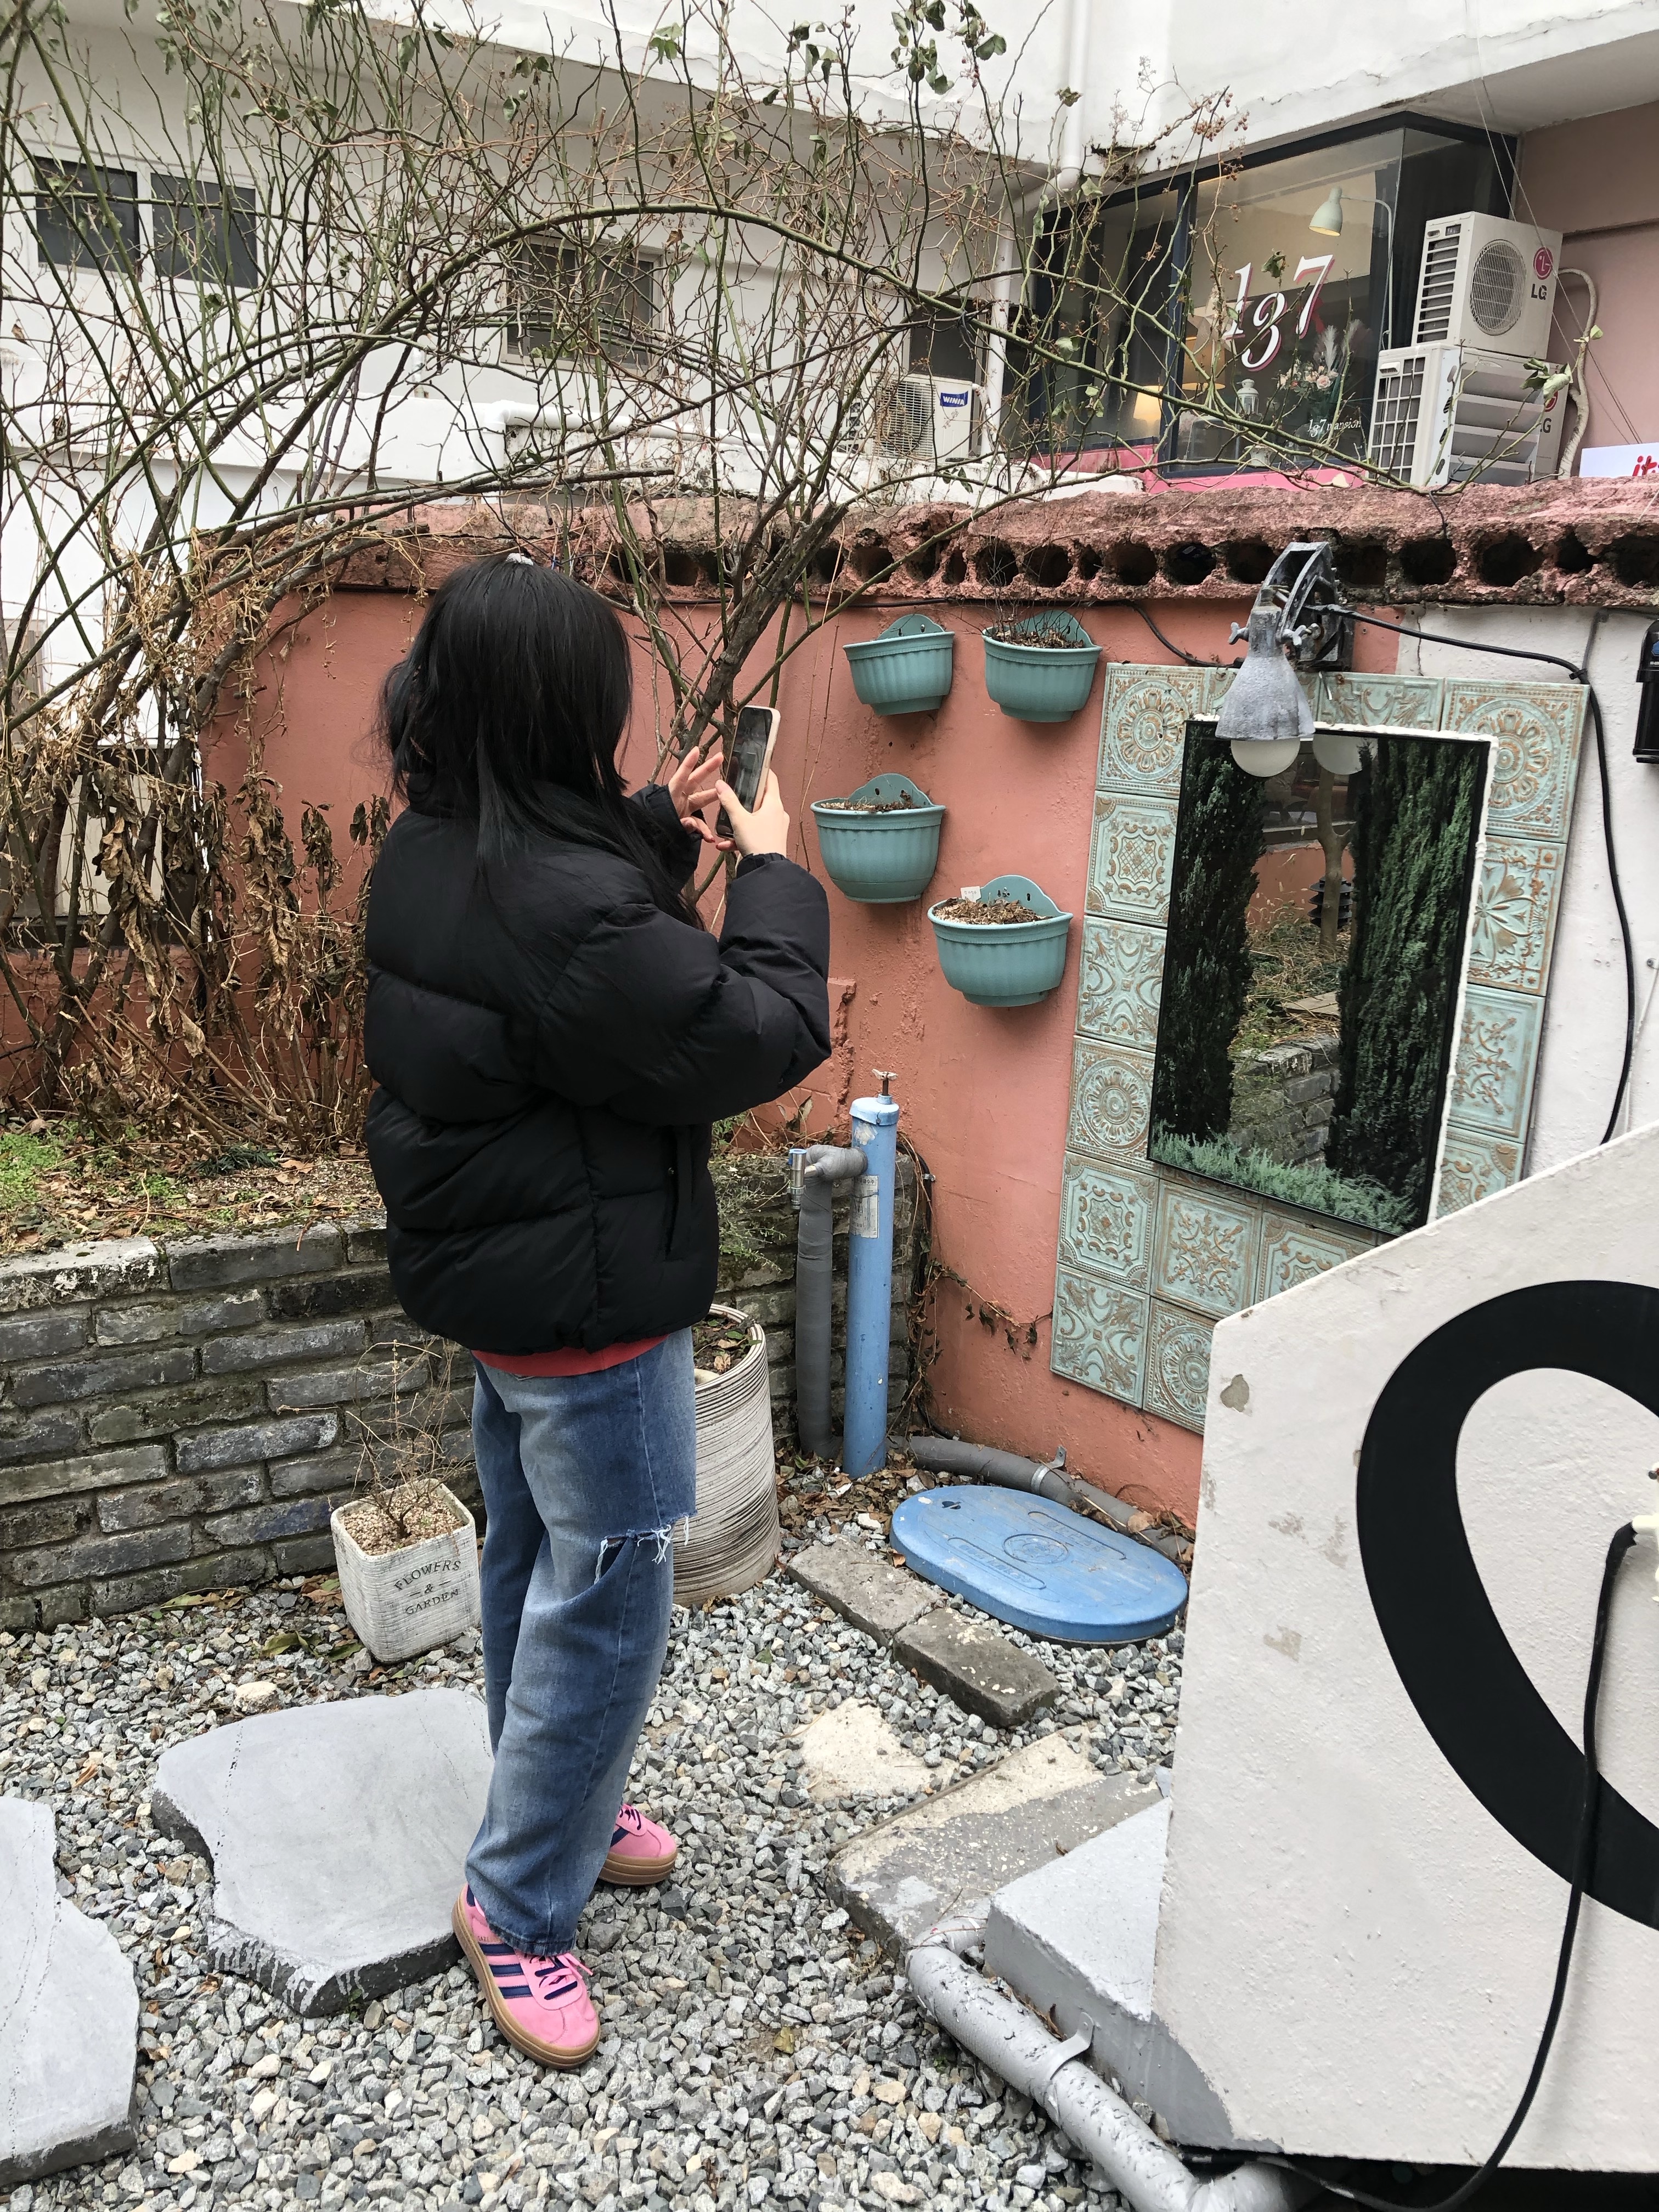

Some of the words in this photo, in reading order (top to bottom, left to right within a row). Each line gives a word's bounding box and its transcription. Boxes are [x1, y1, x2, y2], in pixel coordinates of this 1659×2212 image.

[1531, 283, 1547, 301] LG
[943, 396, 965, 405] WINIA
[1540, 417, 1552, 433] G
[394, 1560, 461, 1590] FLOWERS
[425, 1583, 433, 1594] &
[405, 1589, 459, 1614] GARDEN
